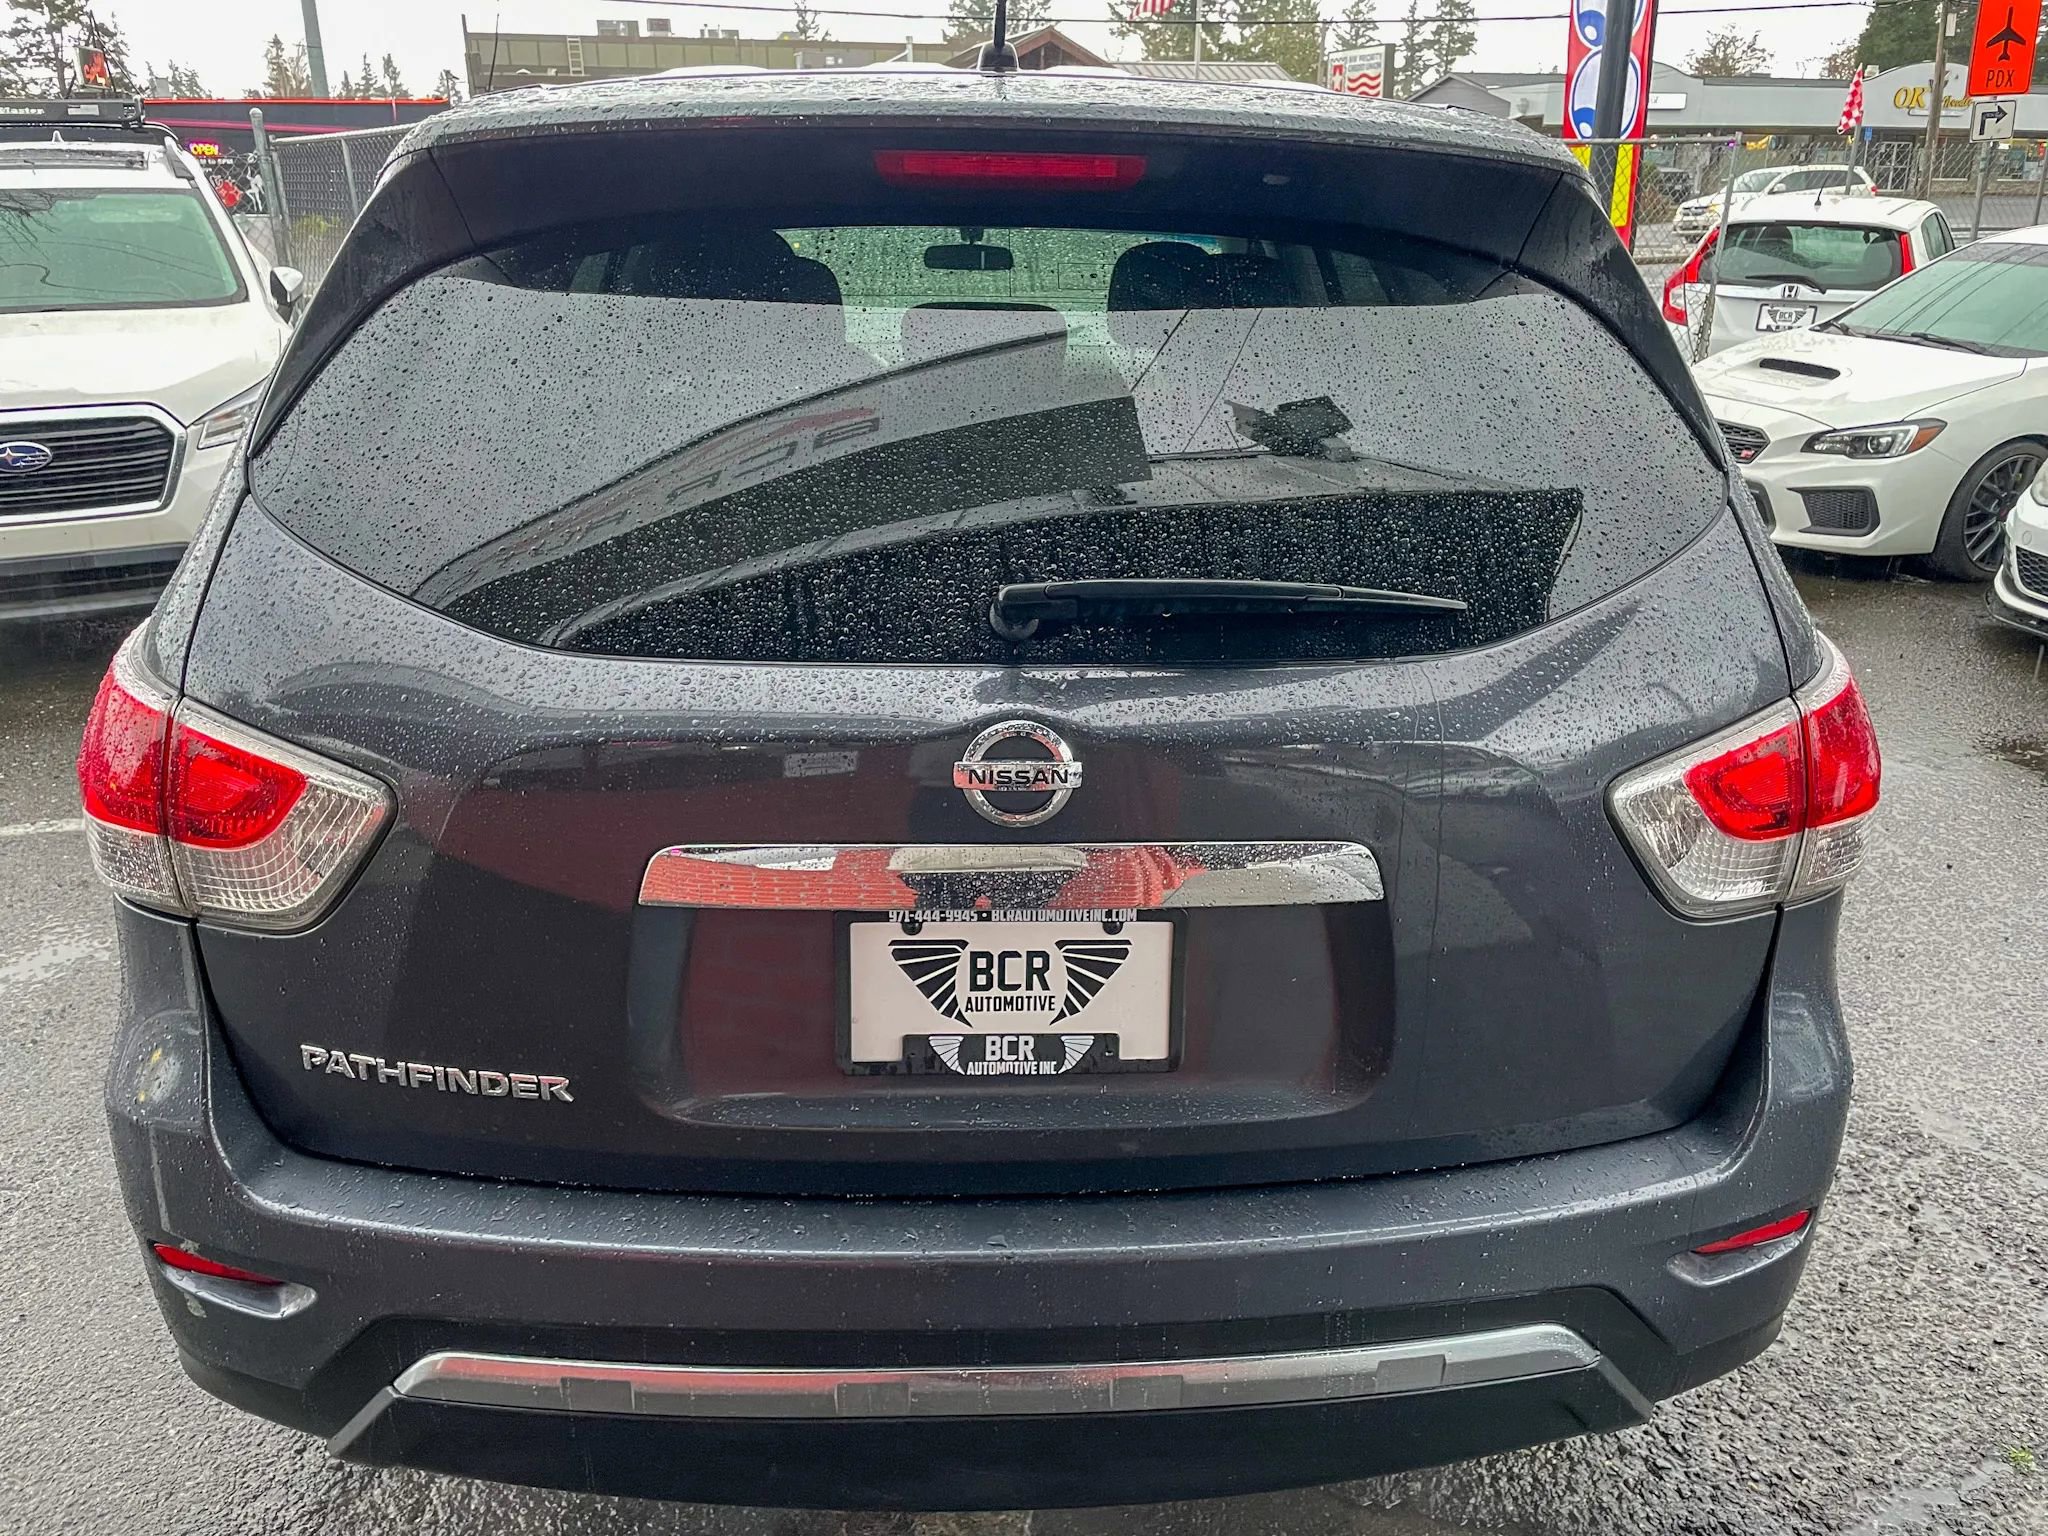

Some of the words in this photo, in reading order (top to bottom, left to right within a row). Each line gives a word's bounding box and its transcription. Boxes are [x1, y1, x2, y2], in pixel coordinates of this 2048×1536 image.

[1986, 70, 2015, 87] PDX
[1894, 86, 1931, 108] OK
[190, 144, 219, 155] OPEN
[968, 769, 1069, 784] NISSAN
[888, 909, 978, 922] 971-444-9945
[991, 909, 1137, 922] BCRAUTOMOTIVEINC.COM
[969, 951, 1051, 992] BCR
[965, 995, 1056, 1012] AUTOMOTIVE
[985, 1035, 1035, 1061] BCR
[300, 1044, 574, 1102] PATHFINDER
[966, 1061, 1038, 1075] AUTOMOTIVE
[1039, 1061, 1057, 1075] INC
